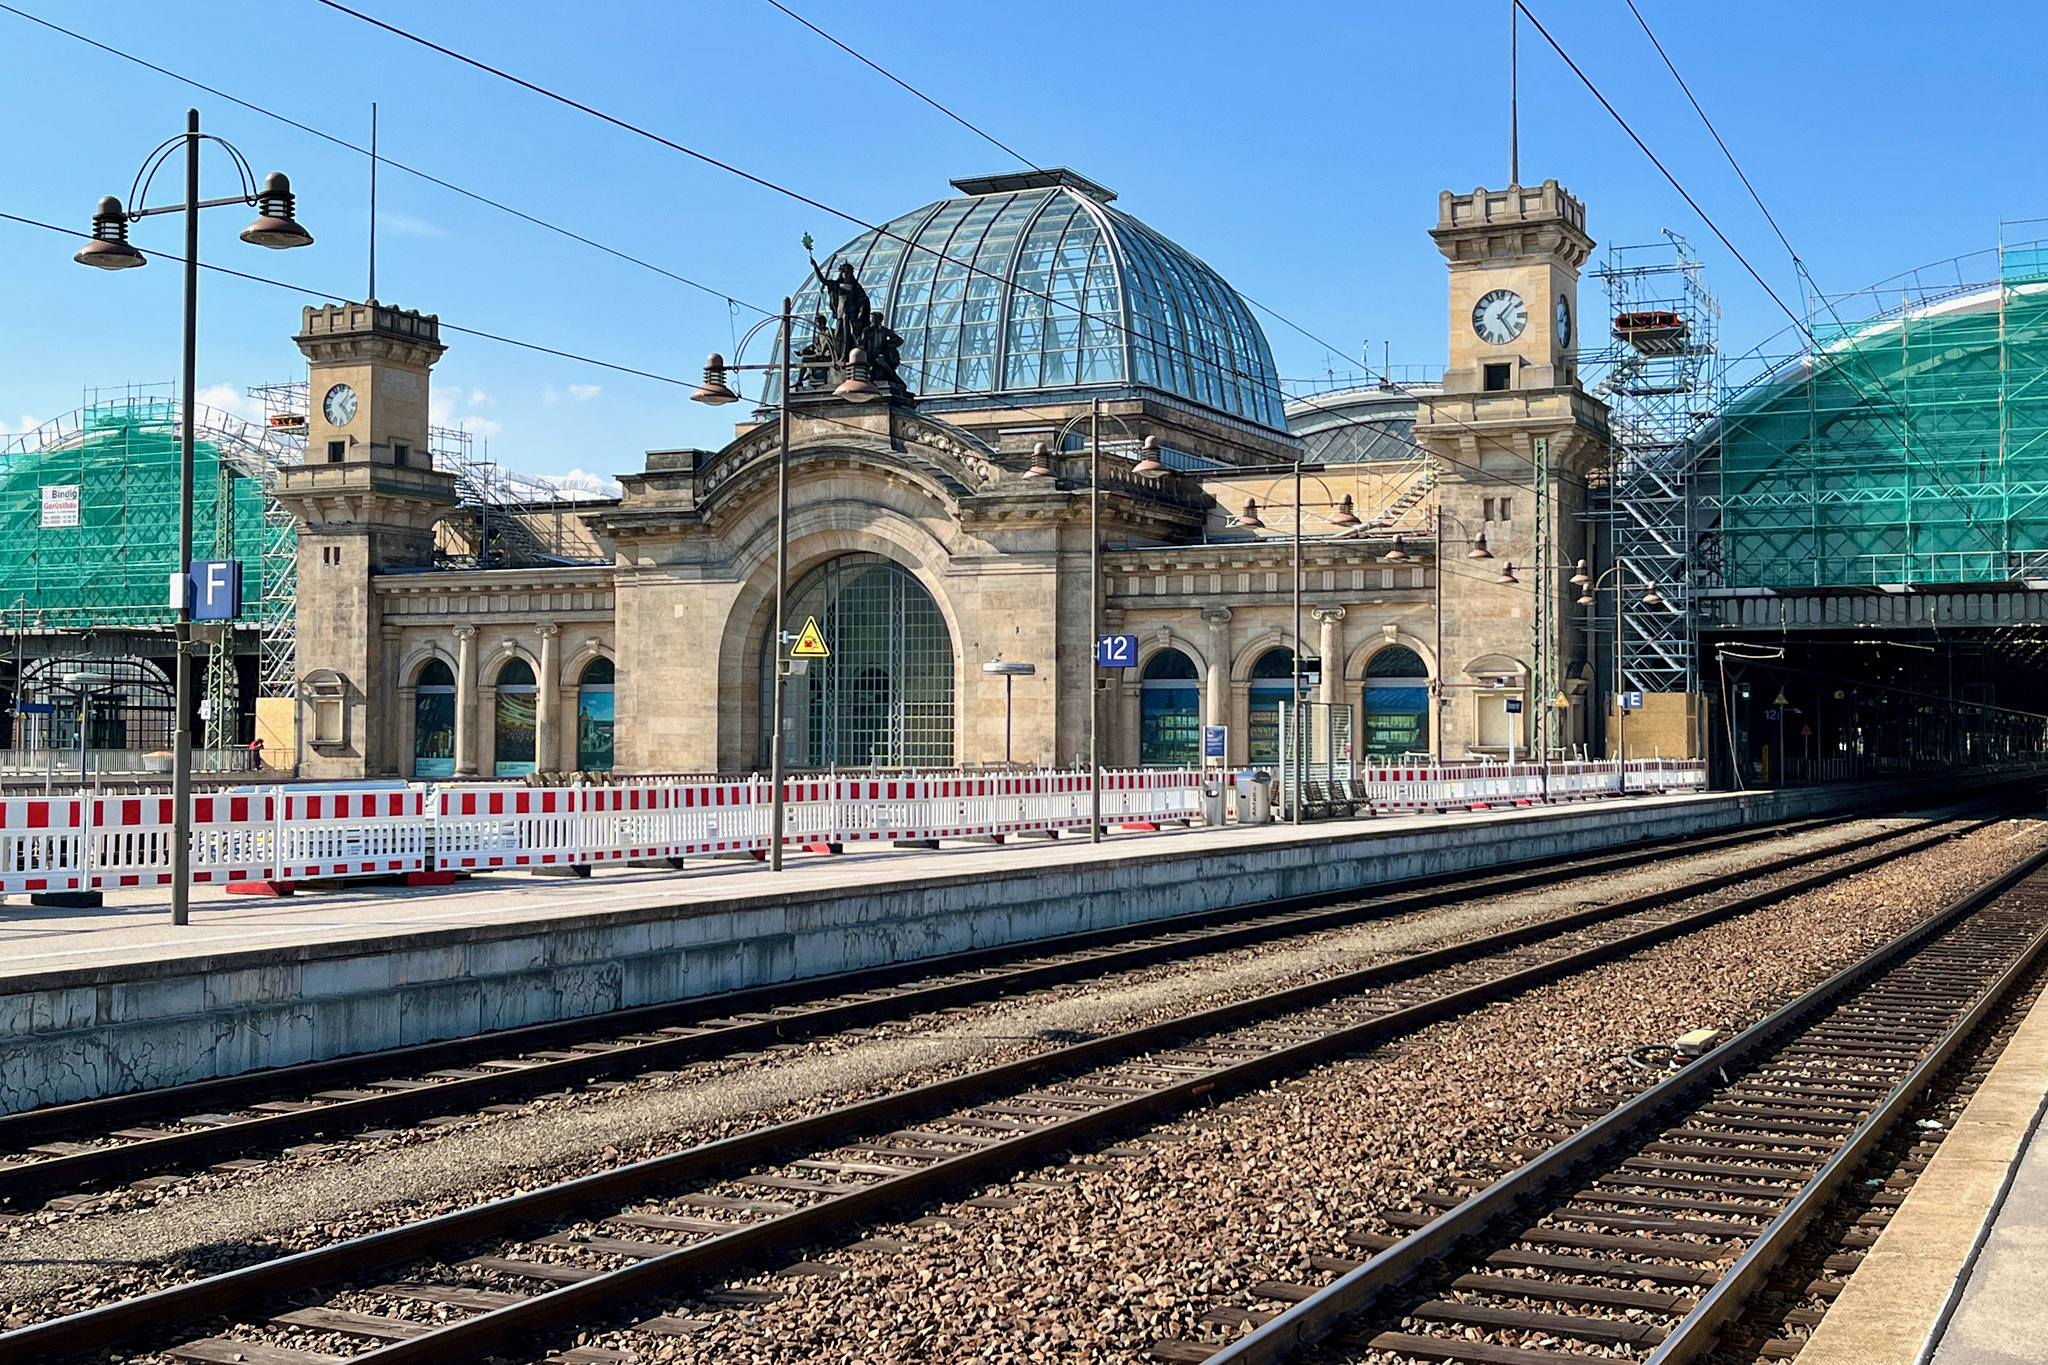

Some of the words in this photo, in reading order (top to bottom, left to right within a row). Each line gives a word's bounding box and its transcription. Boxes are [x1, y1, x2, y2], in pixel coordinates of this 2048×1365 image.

[52, 490, 77, 500] Bindig
[206, 563, 227, 606] F
[1103, 636, 1128, 660] 12
[1630, 691, 1641, 706] E
